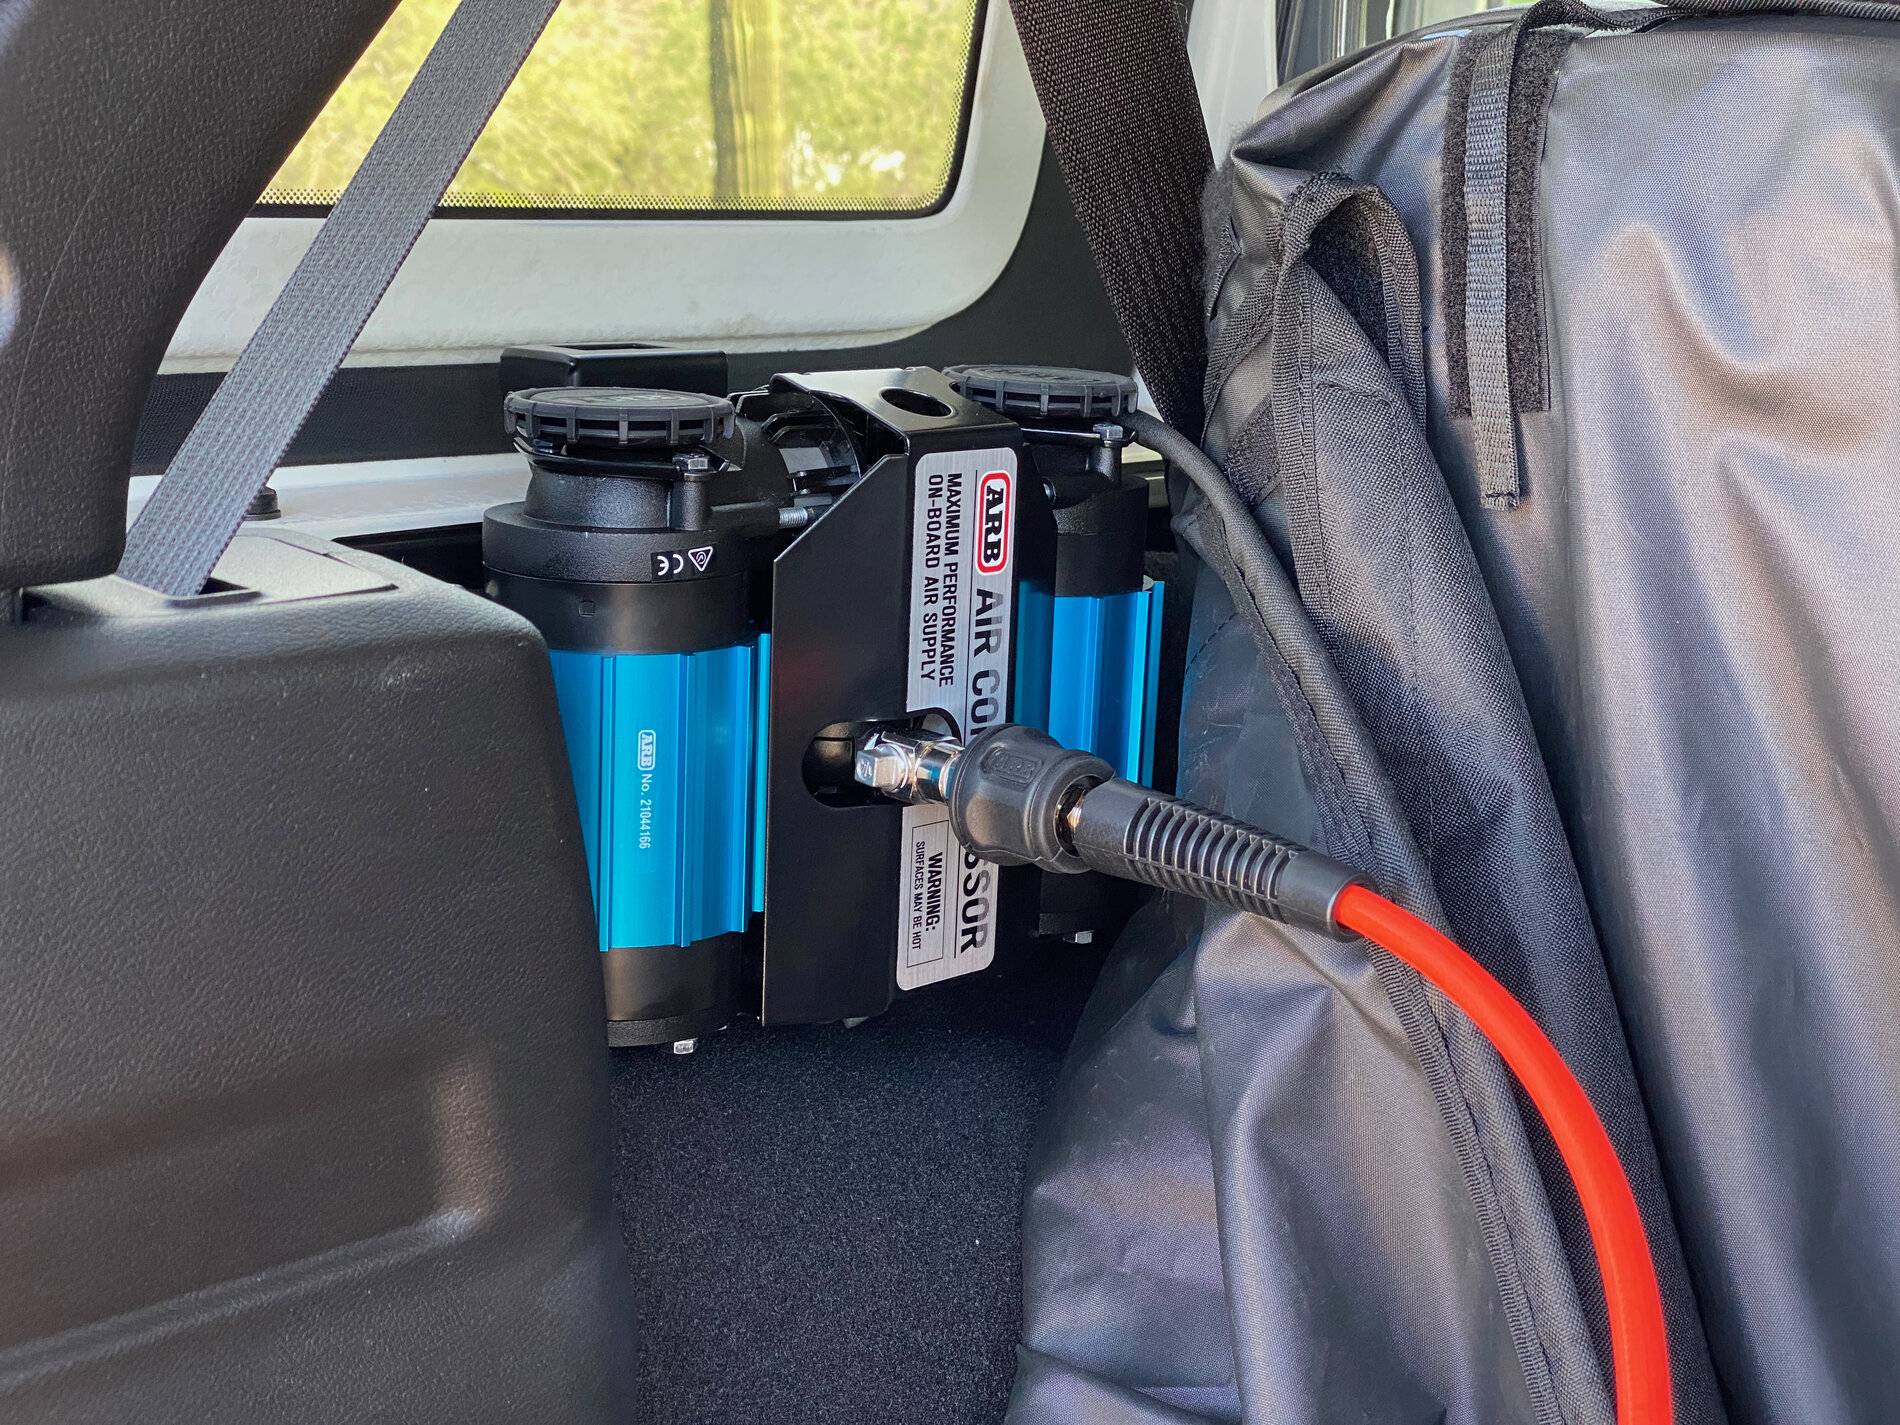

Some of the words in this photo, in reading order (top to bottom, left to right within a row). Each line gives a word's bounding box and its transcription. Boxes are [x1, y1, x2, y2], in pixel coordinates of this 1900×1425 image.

[925, 474, 944, 569] ON-BOARD
[944, 472, 963, 557] MAXIMUM
[984, 485, 1004, 564] ARB
[923, 576, 940, 607] AIR
[920, 612, 939, 681] SUPPLY
[938, 561, 959, 688] PERFORMANCE
[973, 588, 1004, 658] AIR
[640, 733, 653, 768] ARB
[641, 773, 653, 796] No.
[638, 799, 653, 850] 21044166
[914, 841, 925, 891] SURFACES
[925, 851, 943, 932] WARNING:
[912, 915, 922, 929] BE
[913, 892, 924, 913] MAY
[911, 931, 922, 950] HOT
